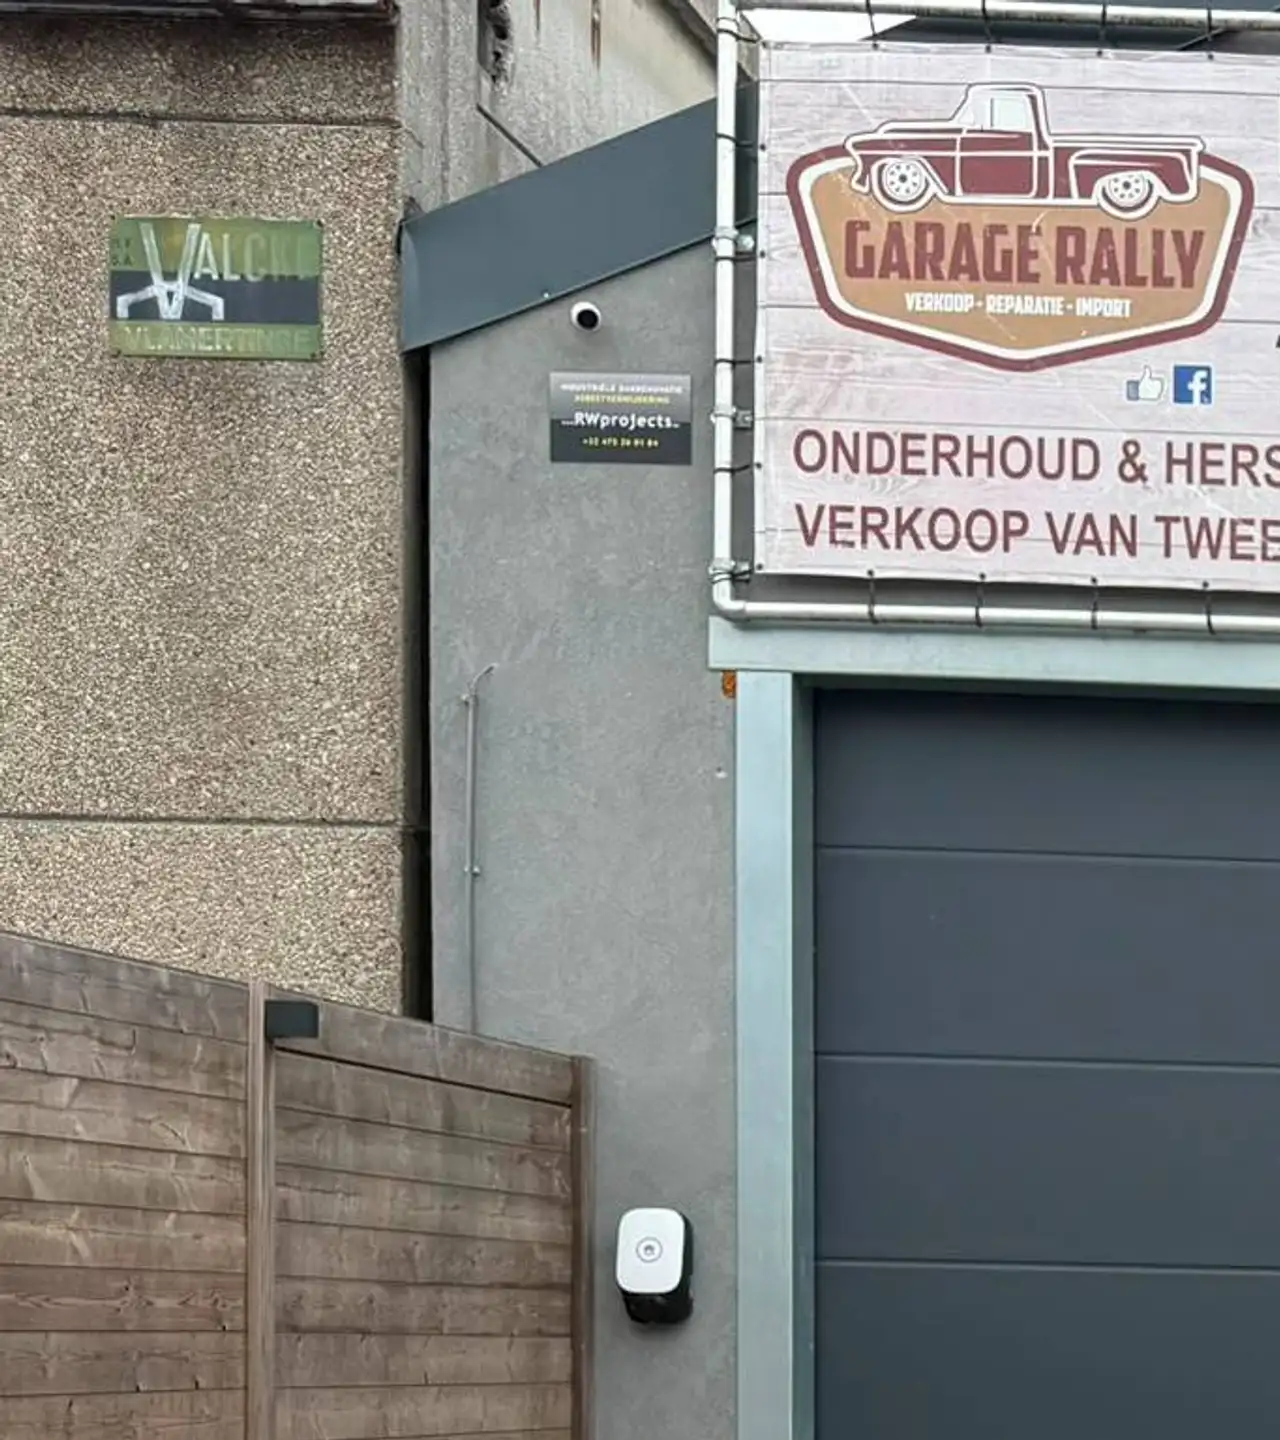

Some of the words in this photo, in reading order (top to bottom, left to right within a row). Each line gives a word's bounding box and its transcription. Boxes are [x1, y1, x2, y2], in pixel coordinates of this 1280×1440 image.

[844, 219, 1042, 285] GARAGE
[1055, 226, 1206, 289] RALLY
[905, 292, 974, 313] VERKOOP
[985, 295, 1063, 316] REPARATIE
[1075, 299, 1131, 319] IMPORT
[793, 428, 1099, 482] ONDERHOUD
[1117, 439, 1148, 484] &
[795, 504, 1030, 553] VERKOOP
[1045, 511, 1138, 557] VAN
